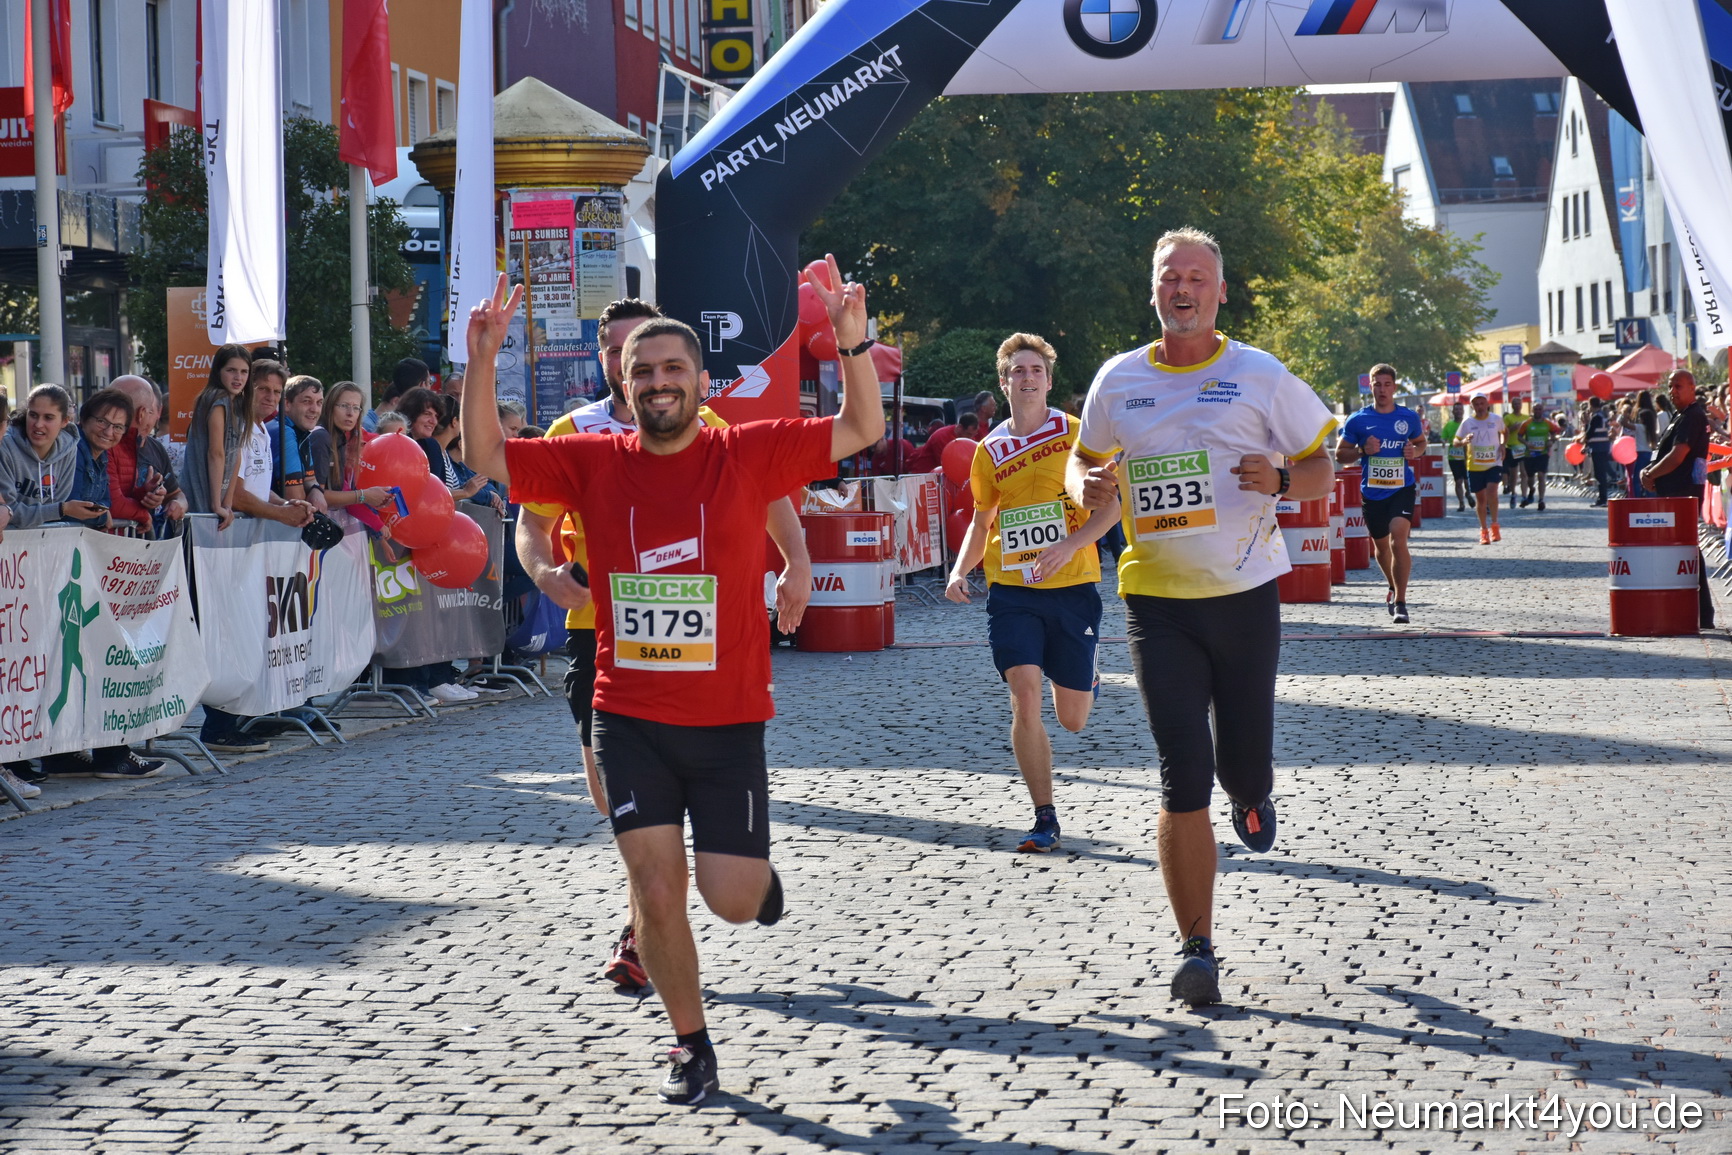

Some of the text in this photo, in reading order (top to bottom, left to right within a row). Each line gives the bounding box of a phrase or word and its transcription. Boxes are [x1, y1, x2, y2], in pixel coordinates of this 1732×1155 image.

[700, 44, 903, 192] PARTL NEUMARKT
[535, 228, 568, 239] SUNRISE
[538, 273, 571, 282] 20 JAHRE
[543, 293, 559, 301] 18.30
[709, 379, 733, 388] NEXT
[1197, 397, 1233, 405] Stadtlauf
[995, 440, 1073, 484] MAX BÖGL
[1134, 458, 1198, 478] BOCK
[1372, 468, 1399, 478] 5081
[1139, 481, 1203, 512] 5233
[1004, 506, 1052, 526] BOCK
[1154, 516, 1189, 530] JÖRG
[1007, 524, 1060, 550] 5100
[656, 548, 683, 563] DEHN
[107, 578, 126, 593] 91
[123, 581, 138, 597] 81
[619, 579, 704, 599] BOCK
[624, 607, 704, 638] 5179
[640, 646, 682, 660] SAAD
